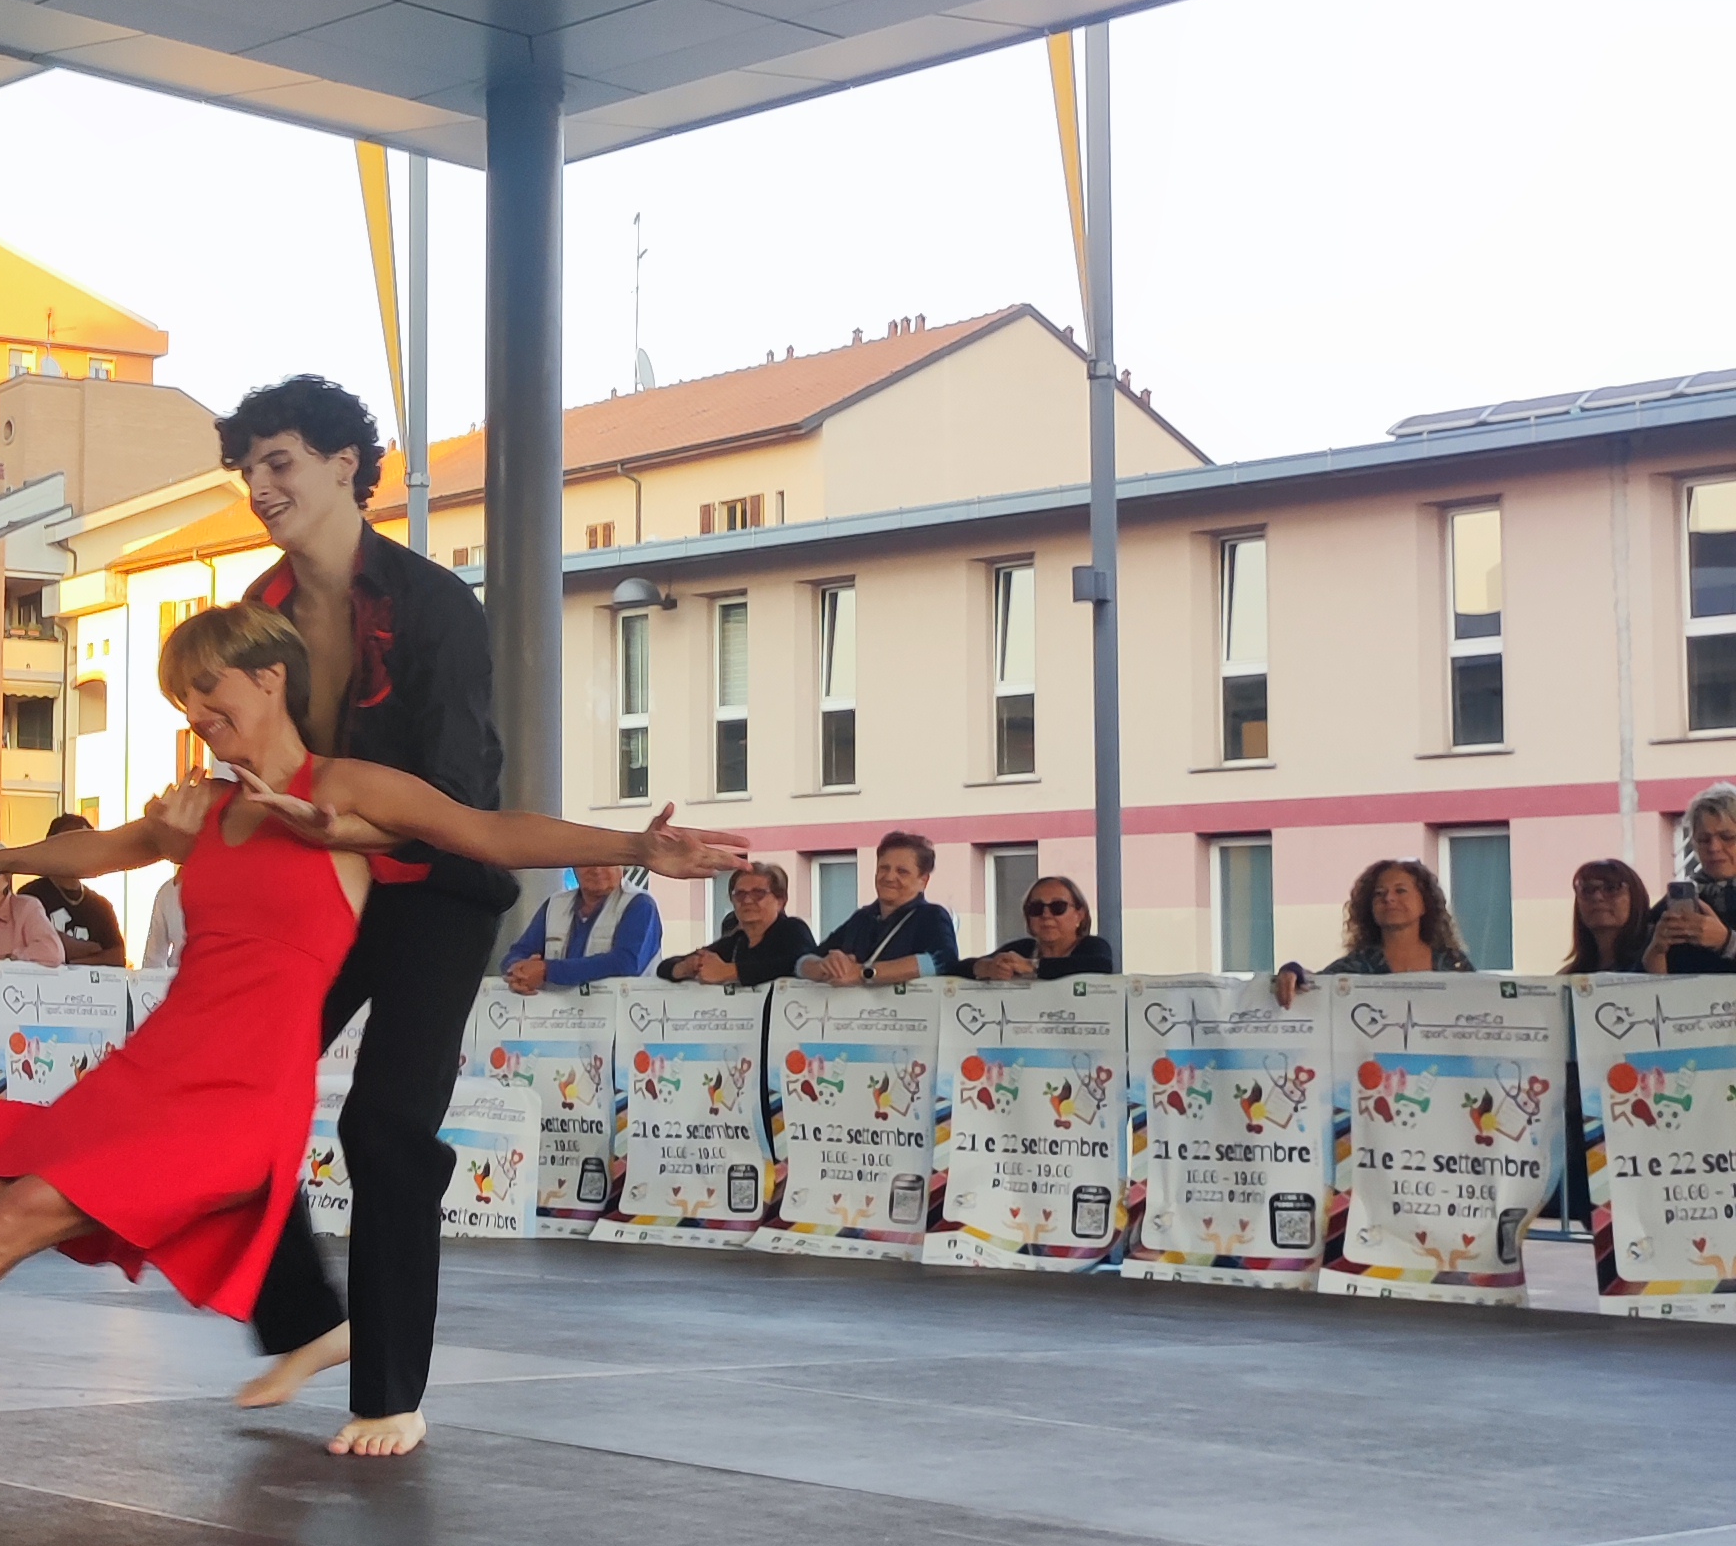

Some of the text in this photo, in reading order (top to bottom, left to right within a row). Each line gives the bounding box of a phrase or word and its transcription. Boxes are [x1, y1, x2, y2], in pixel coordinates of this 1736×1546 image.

[631, 1120, 648, 1138] 21
[651, 1124, 660, 1138] e
[664, 1121, 682, 1139] 22
[789, 1122, 924, 1148] 21 e 22 settembre
[955, 1132, 1109, 1158] 21 e 22 settembre
[1152, 1139, 1311, 1163] 21 e 22 settembre
[1357, 1147, 1541, 1178] 21 e 22 settembre
[1615, 1155, 1642, 1177] 21
[1648, 1157, 1662, 1176] e
[1668, 1151, 1696, 1175] 22
[1392, 1201, 1441, 1216] piazza
[1665, 1207, 1718, 1224] piazza
